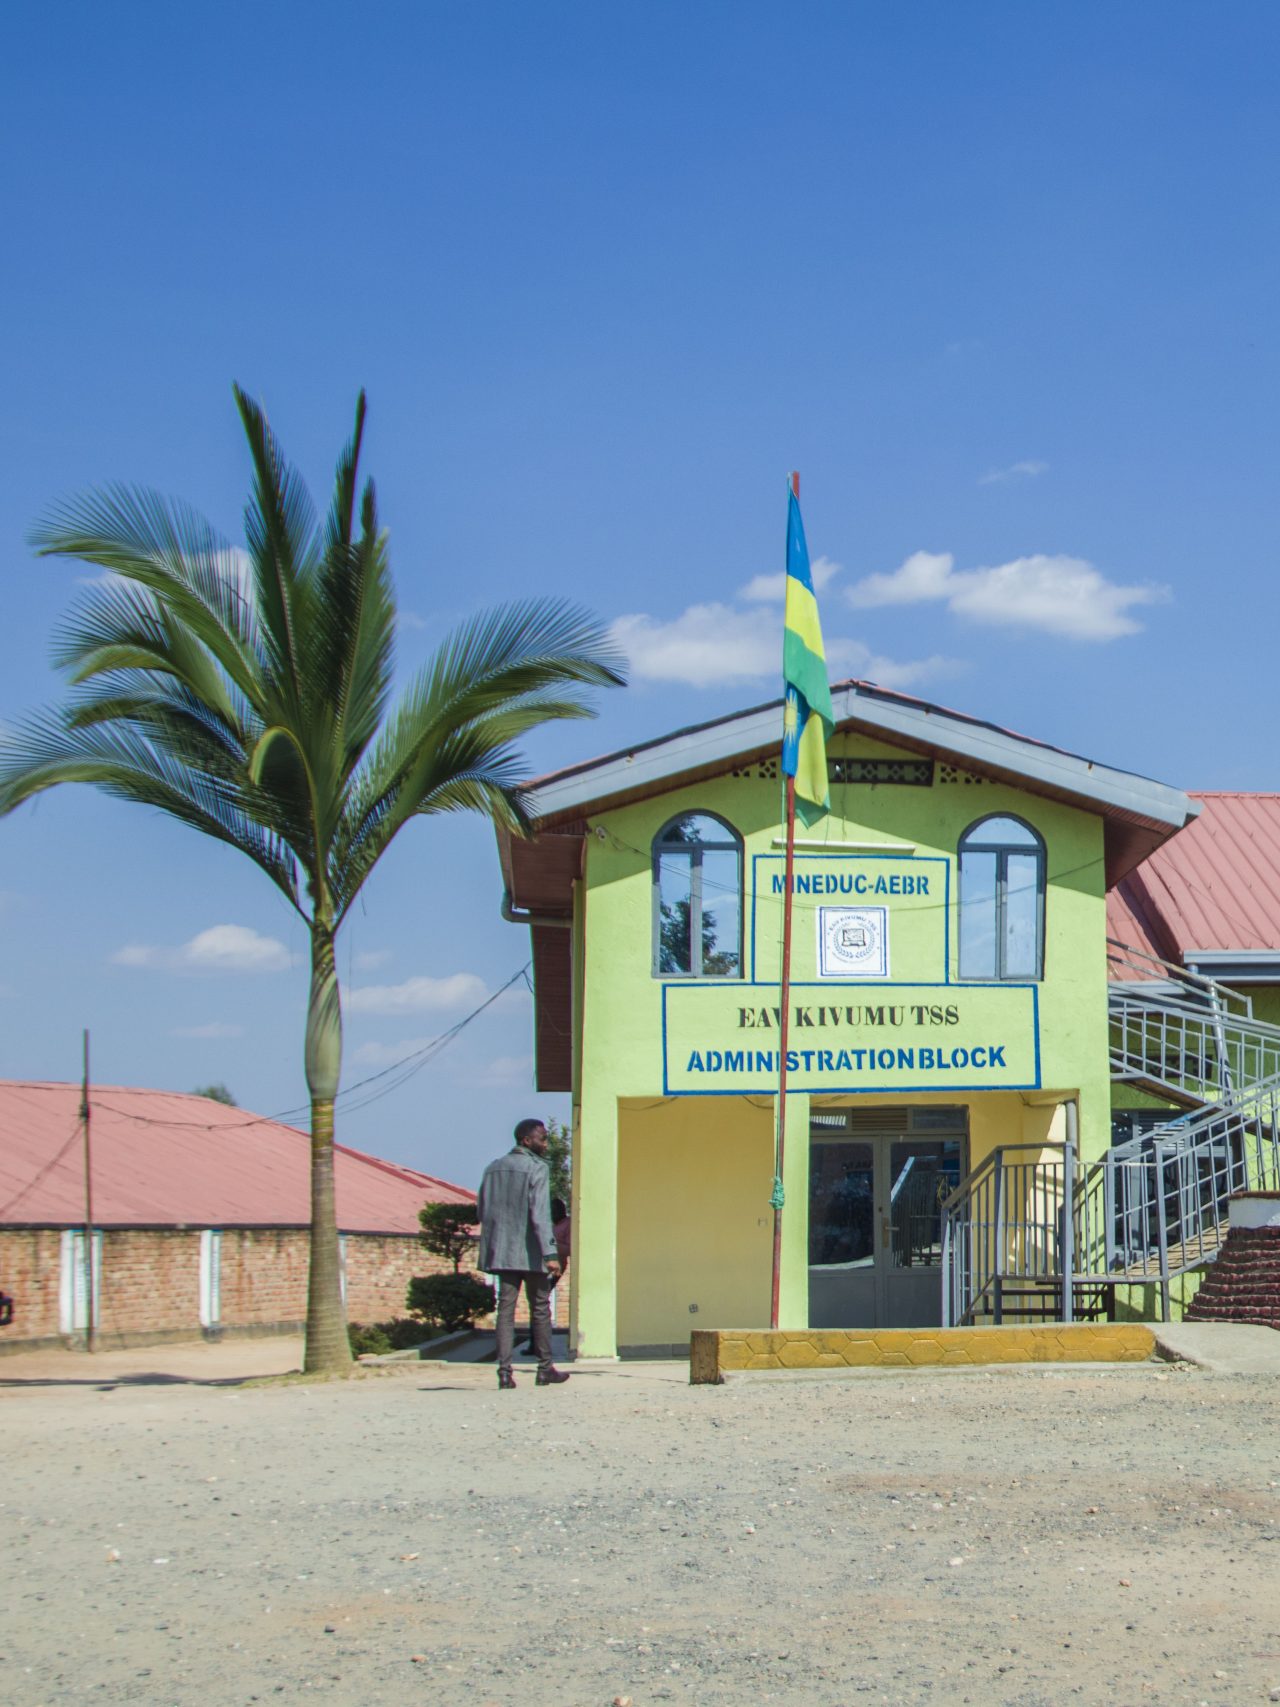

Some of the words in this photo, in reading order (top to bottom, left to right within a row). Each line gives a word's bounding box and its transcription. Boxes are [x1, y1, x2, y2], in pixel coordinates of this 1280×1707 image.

[772, 874, 929, 895] MINEDUC-AEBR
[794, 1006, 905, 1027] KIVUMU
[911, 1005, 960, 1026] TSS
